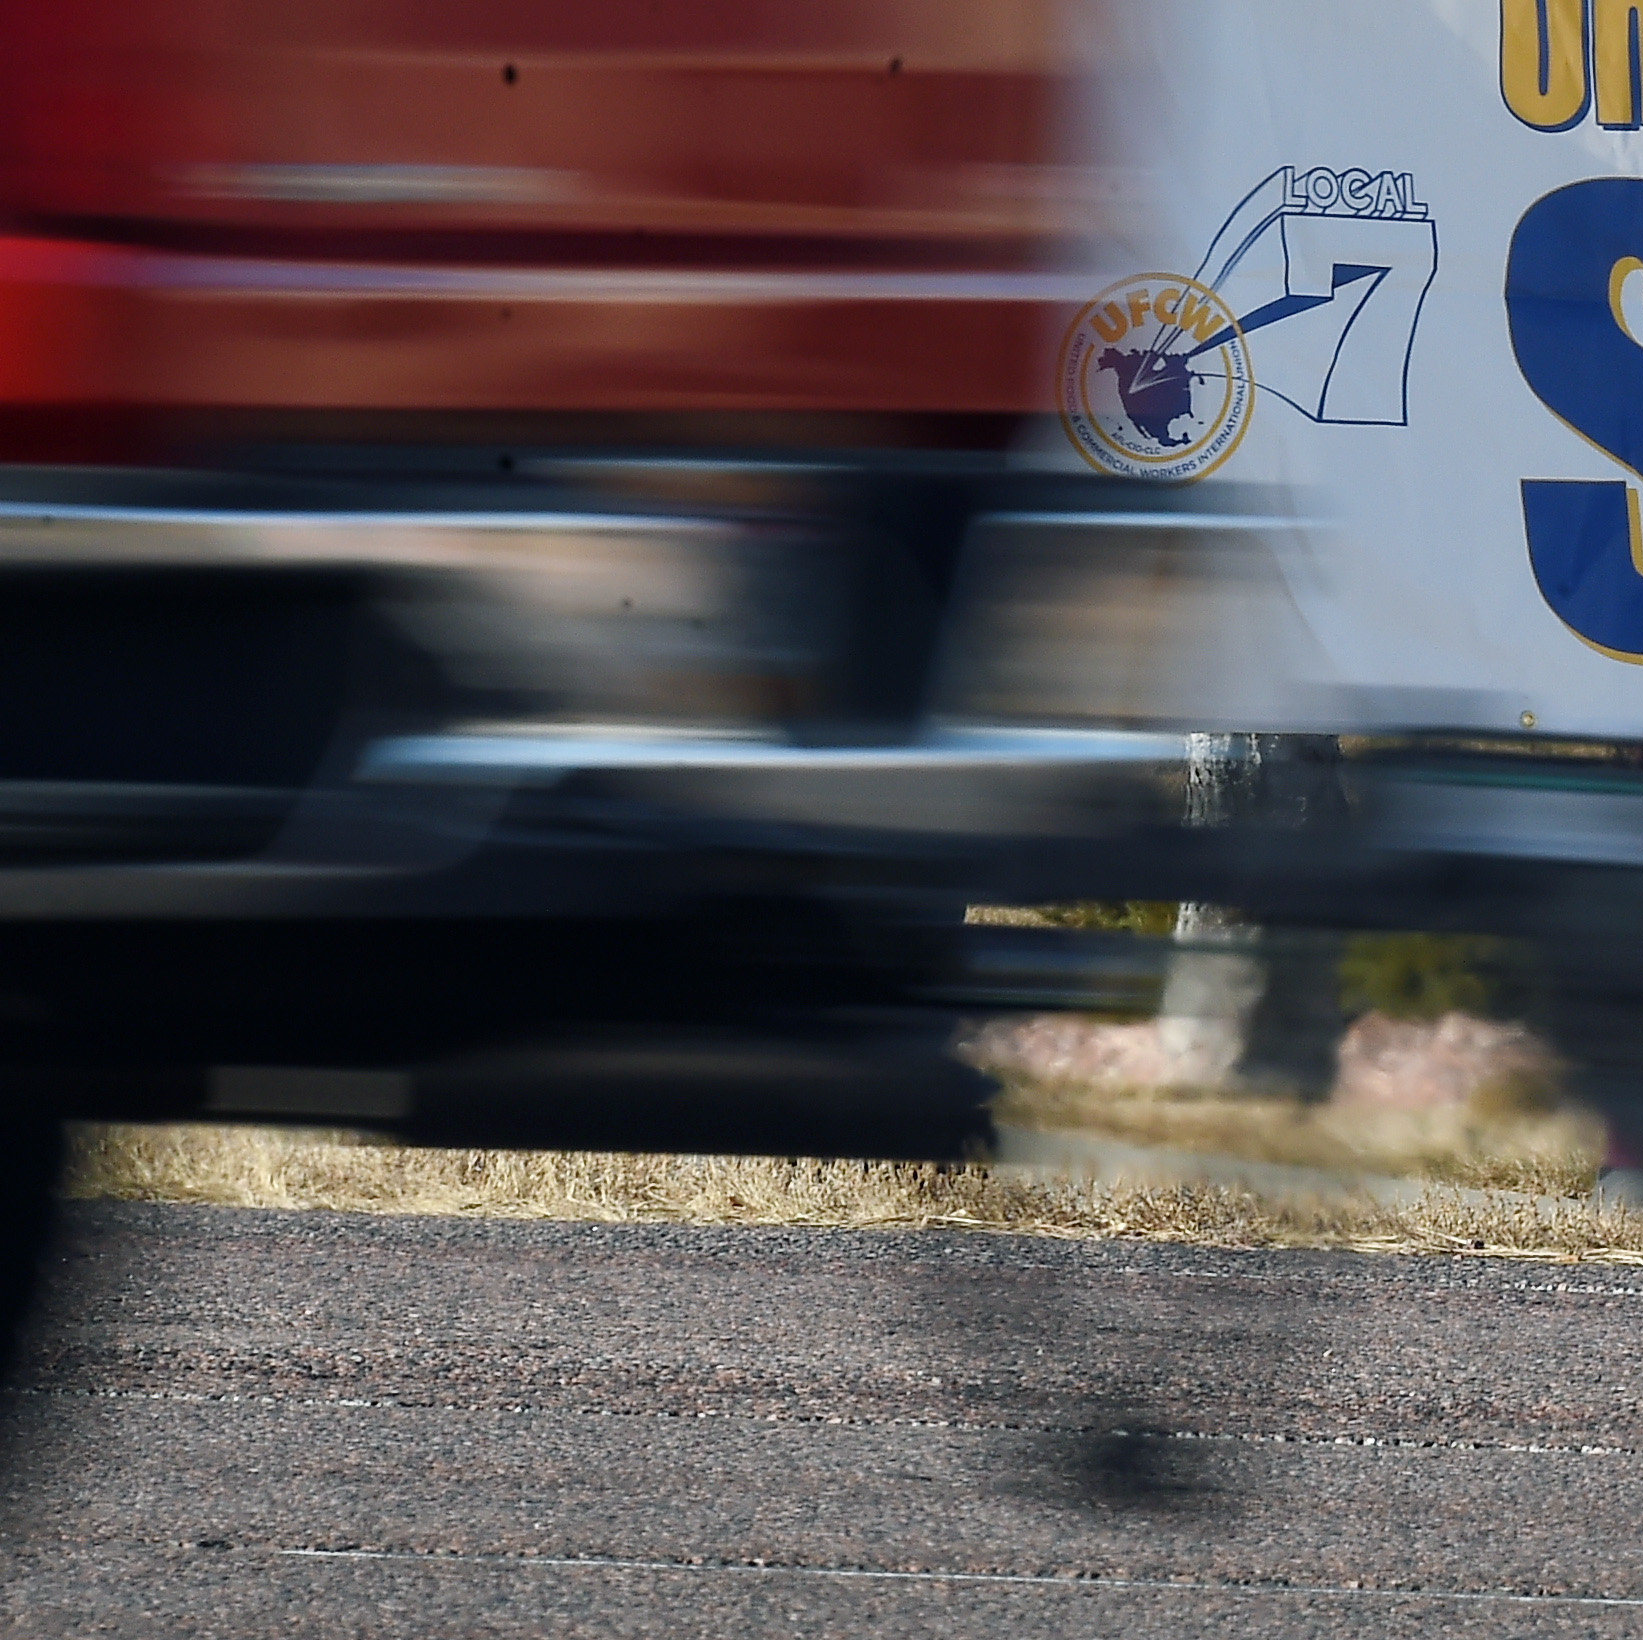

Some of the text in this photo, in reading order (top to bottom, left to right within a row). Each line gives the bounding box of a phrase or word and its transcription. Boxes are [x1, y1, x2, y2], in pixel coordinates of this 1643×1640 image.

[1283, 166, 1428, 220] LOCAL
[1090, 288, 1226, 343] UFCW
[1281, 212, 1439, 427] 7
[1077, 424, 1136, 476] COMMERCIAL
[1139, 460, 1197, 479] WORKERS
[1198, 379, 1246, 464] INTERNATIONAL
